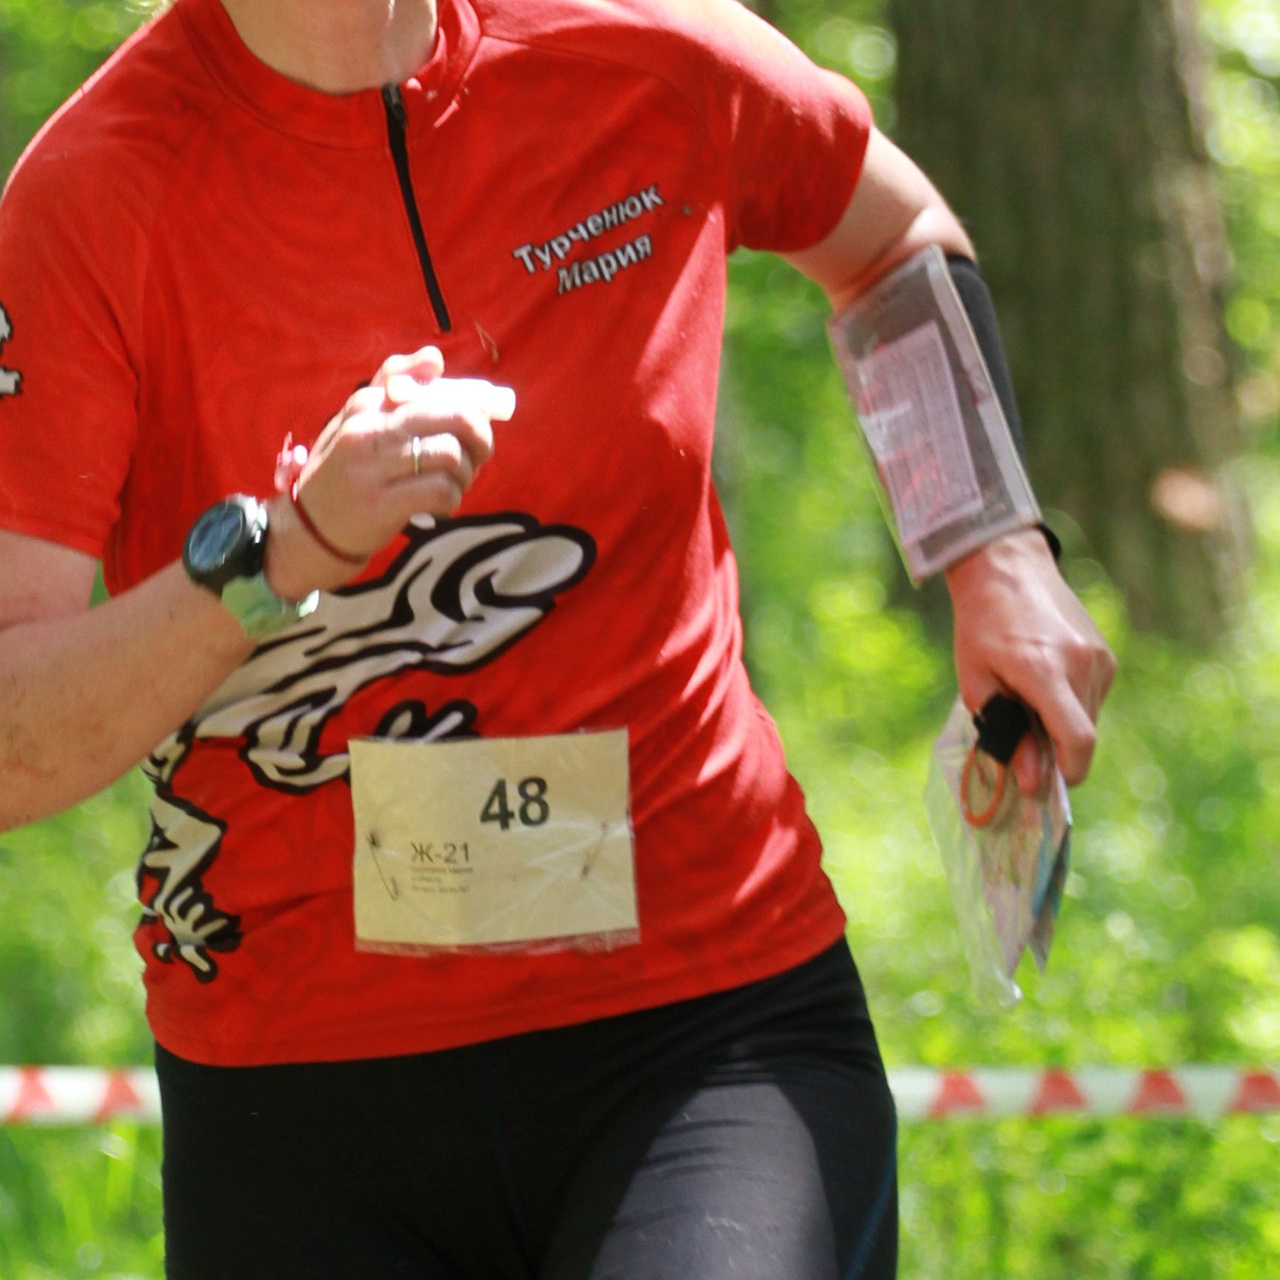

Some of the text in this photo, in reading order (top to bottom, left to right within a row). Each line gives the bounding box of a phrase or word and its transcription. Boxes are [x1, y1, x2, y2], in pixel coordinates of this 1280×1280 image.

[557, 234, 653, 295] Мария
[479, 776, 550, 831] 48
[410, 841, 470, 864] Ж-21
